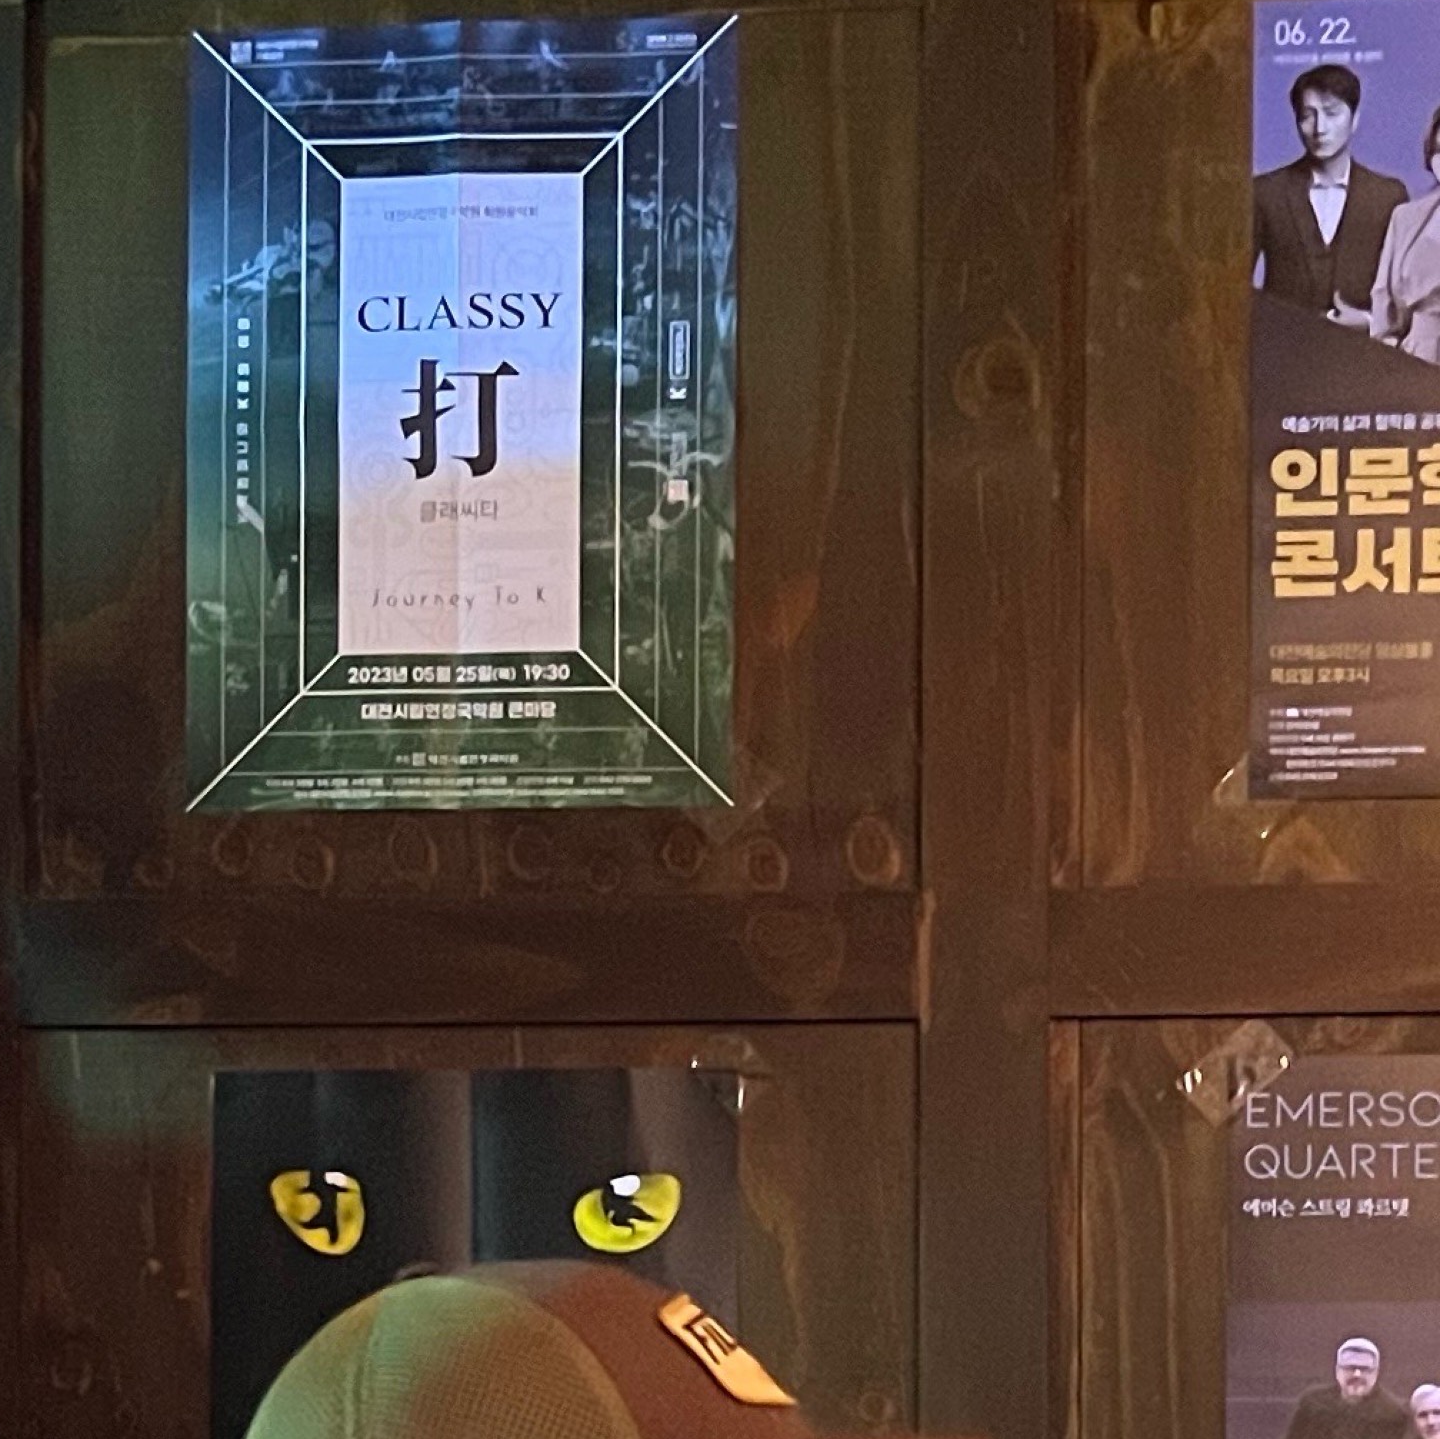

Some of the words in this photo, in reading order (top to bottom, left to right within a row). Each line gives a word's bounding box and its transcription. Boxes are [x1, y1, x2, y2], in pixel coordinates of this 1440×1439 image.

[357, 291, 564, 333] CLASSY
[400, 358, 521, 480] 打
[371, 588, 476, 610] Journey
[494, 585, 521, 605] To
[536, 586, 548, 603] K
[522, 663, 572, 682] 19:30
